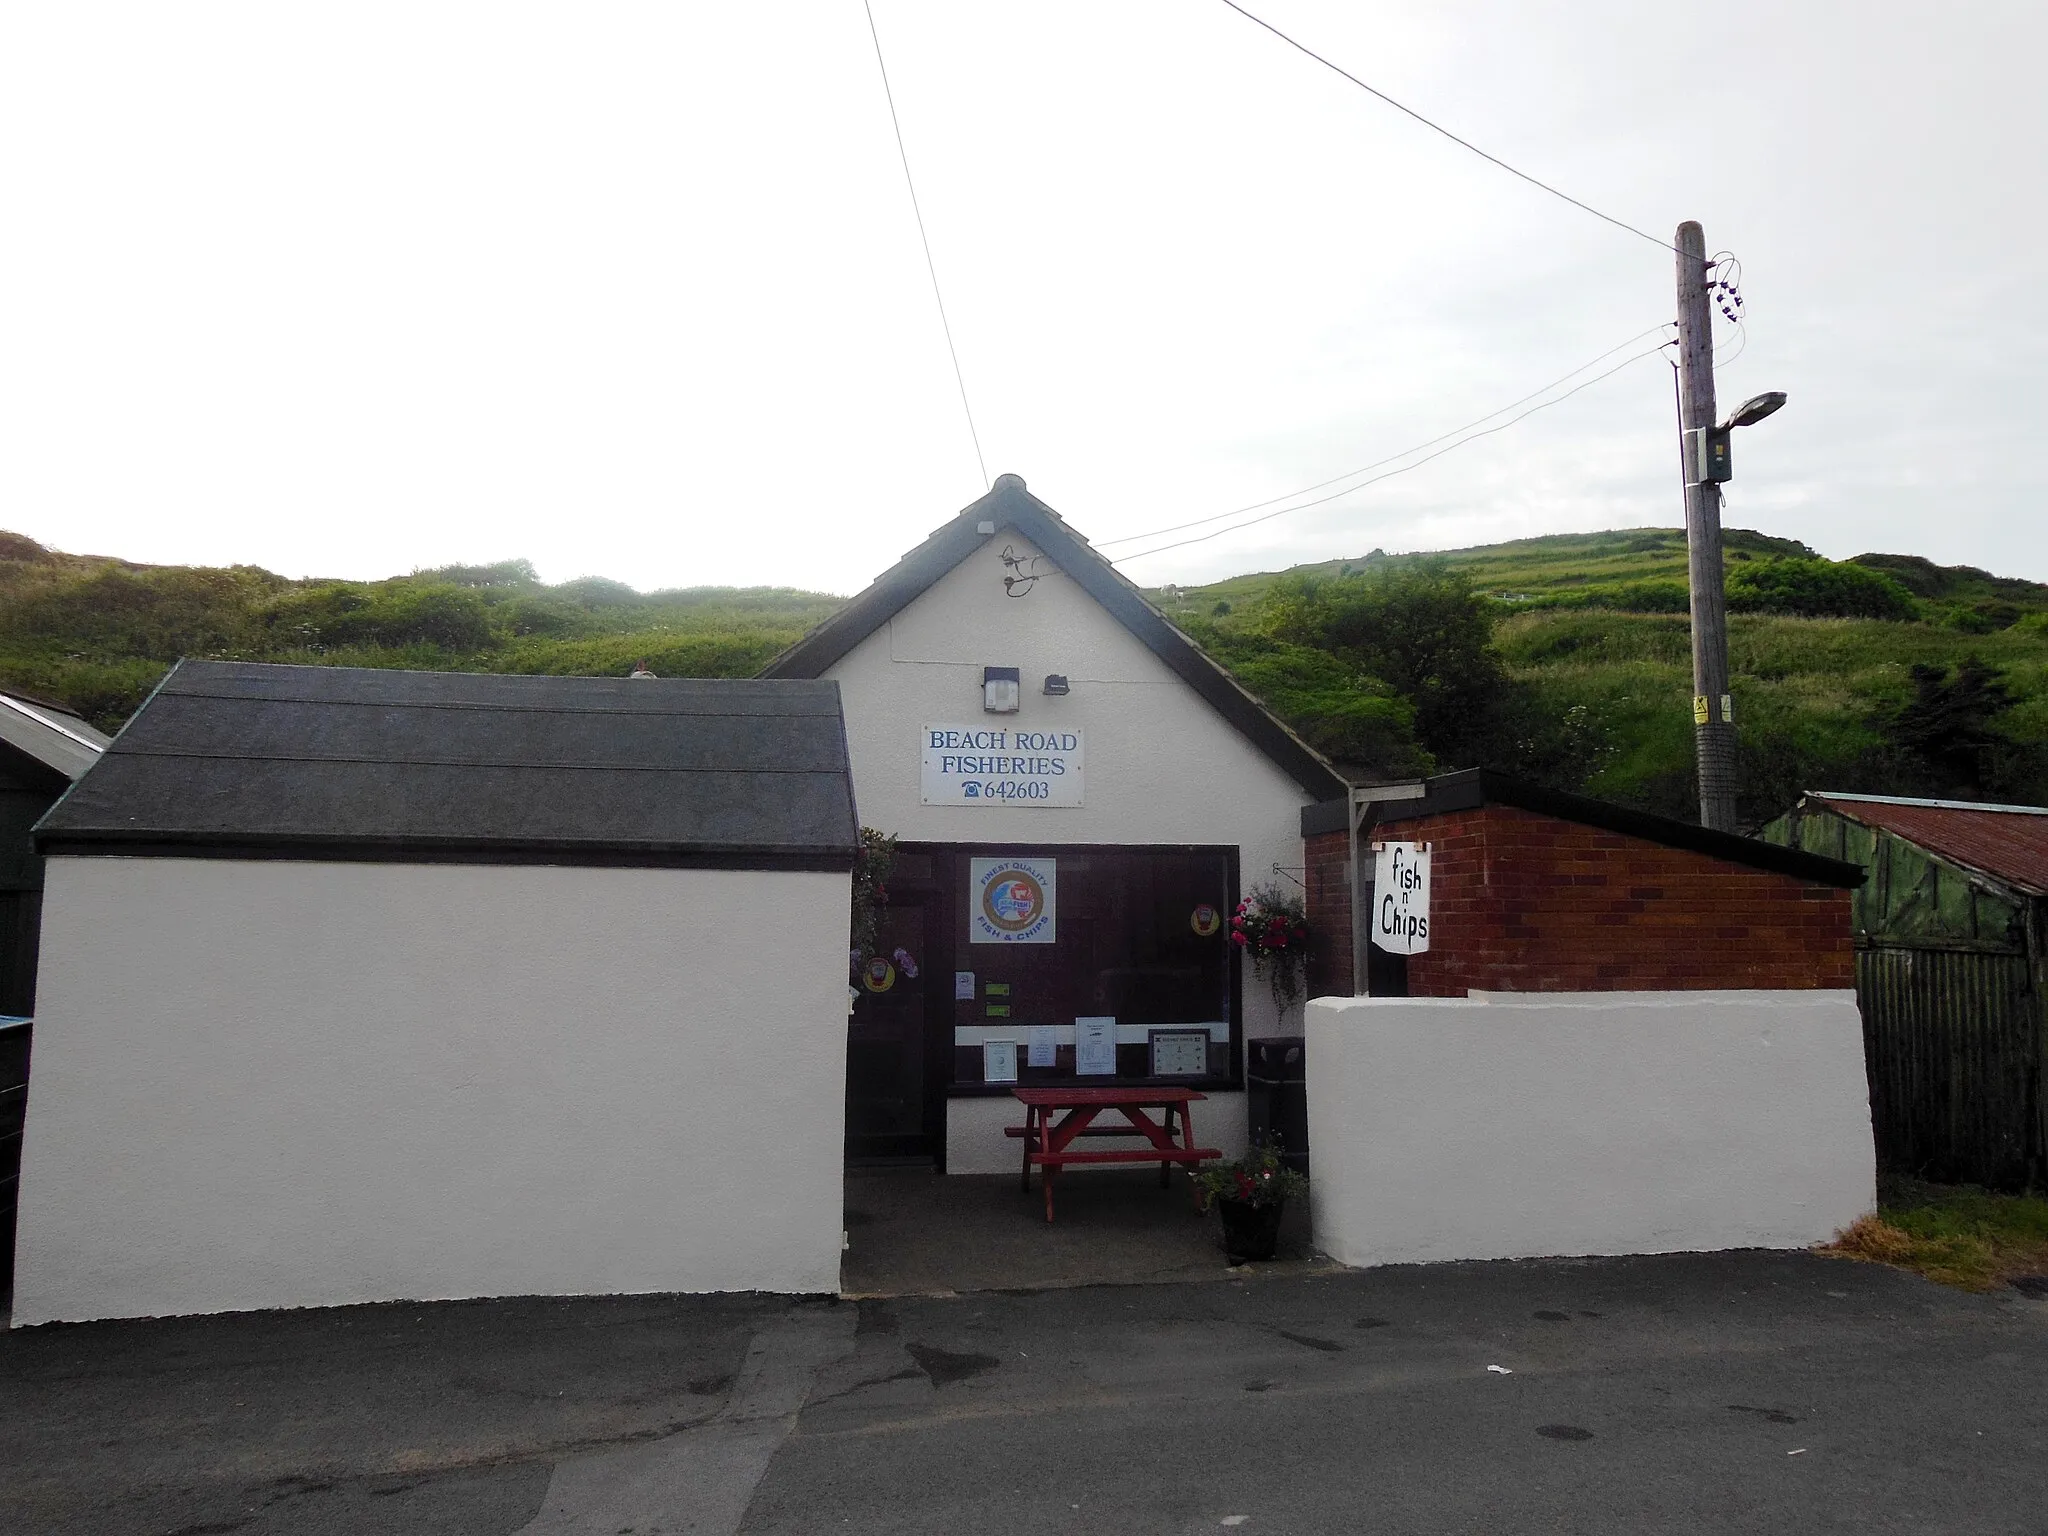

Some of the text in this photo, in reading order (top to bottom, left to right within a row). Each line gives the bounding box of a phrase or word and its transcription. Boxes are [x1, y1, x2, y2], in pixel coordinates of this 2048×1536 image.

[929, 731, 1077, 751] BEACH ROAD
[941, 755, 1066, 776] FISHERIES
[984, 781, 1049, 799] 642603
[980, 862, 1048, 886] FINEST QUALITY
[977, 916, 1001, 938] FISH
[1016, 916, 1049, 940] CHIPS
[1381, 893, 1428, 953] Chips
